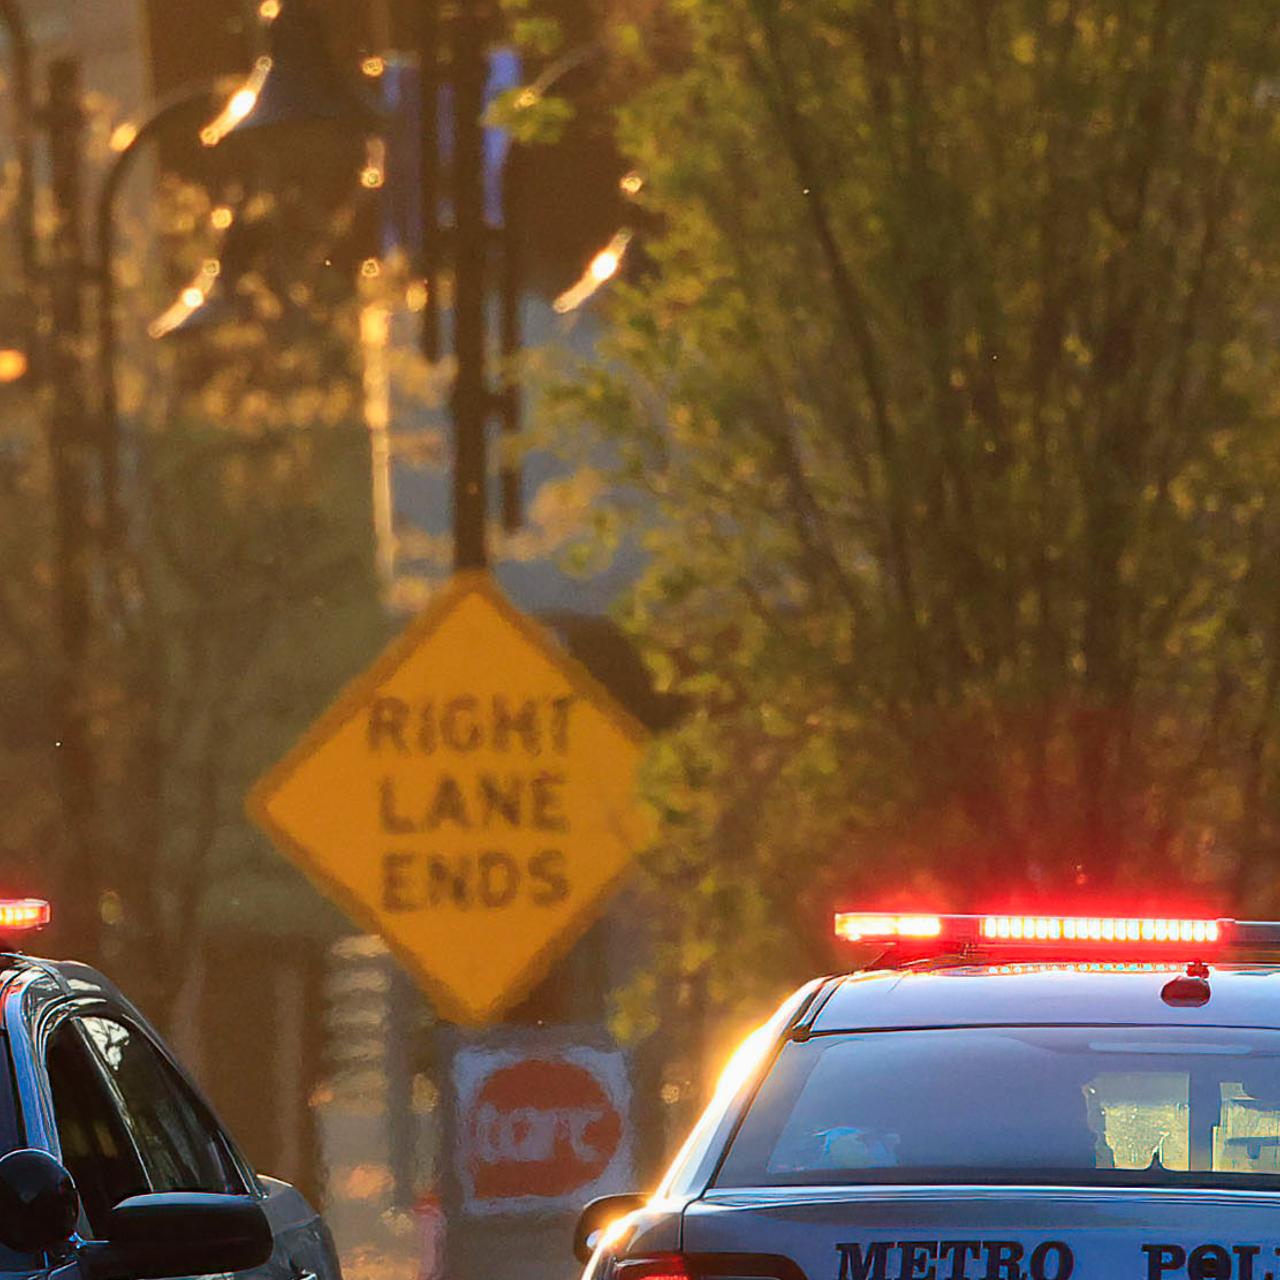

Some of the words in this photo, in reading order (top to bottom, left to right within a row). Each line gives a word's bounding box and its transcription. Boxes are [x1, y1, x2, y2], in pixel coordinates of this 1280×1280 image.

[368, 696, 571, 756] RIGHT
[378, 773, 568, 836] LANE
[380, 851, 569, 911] ENDS
